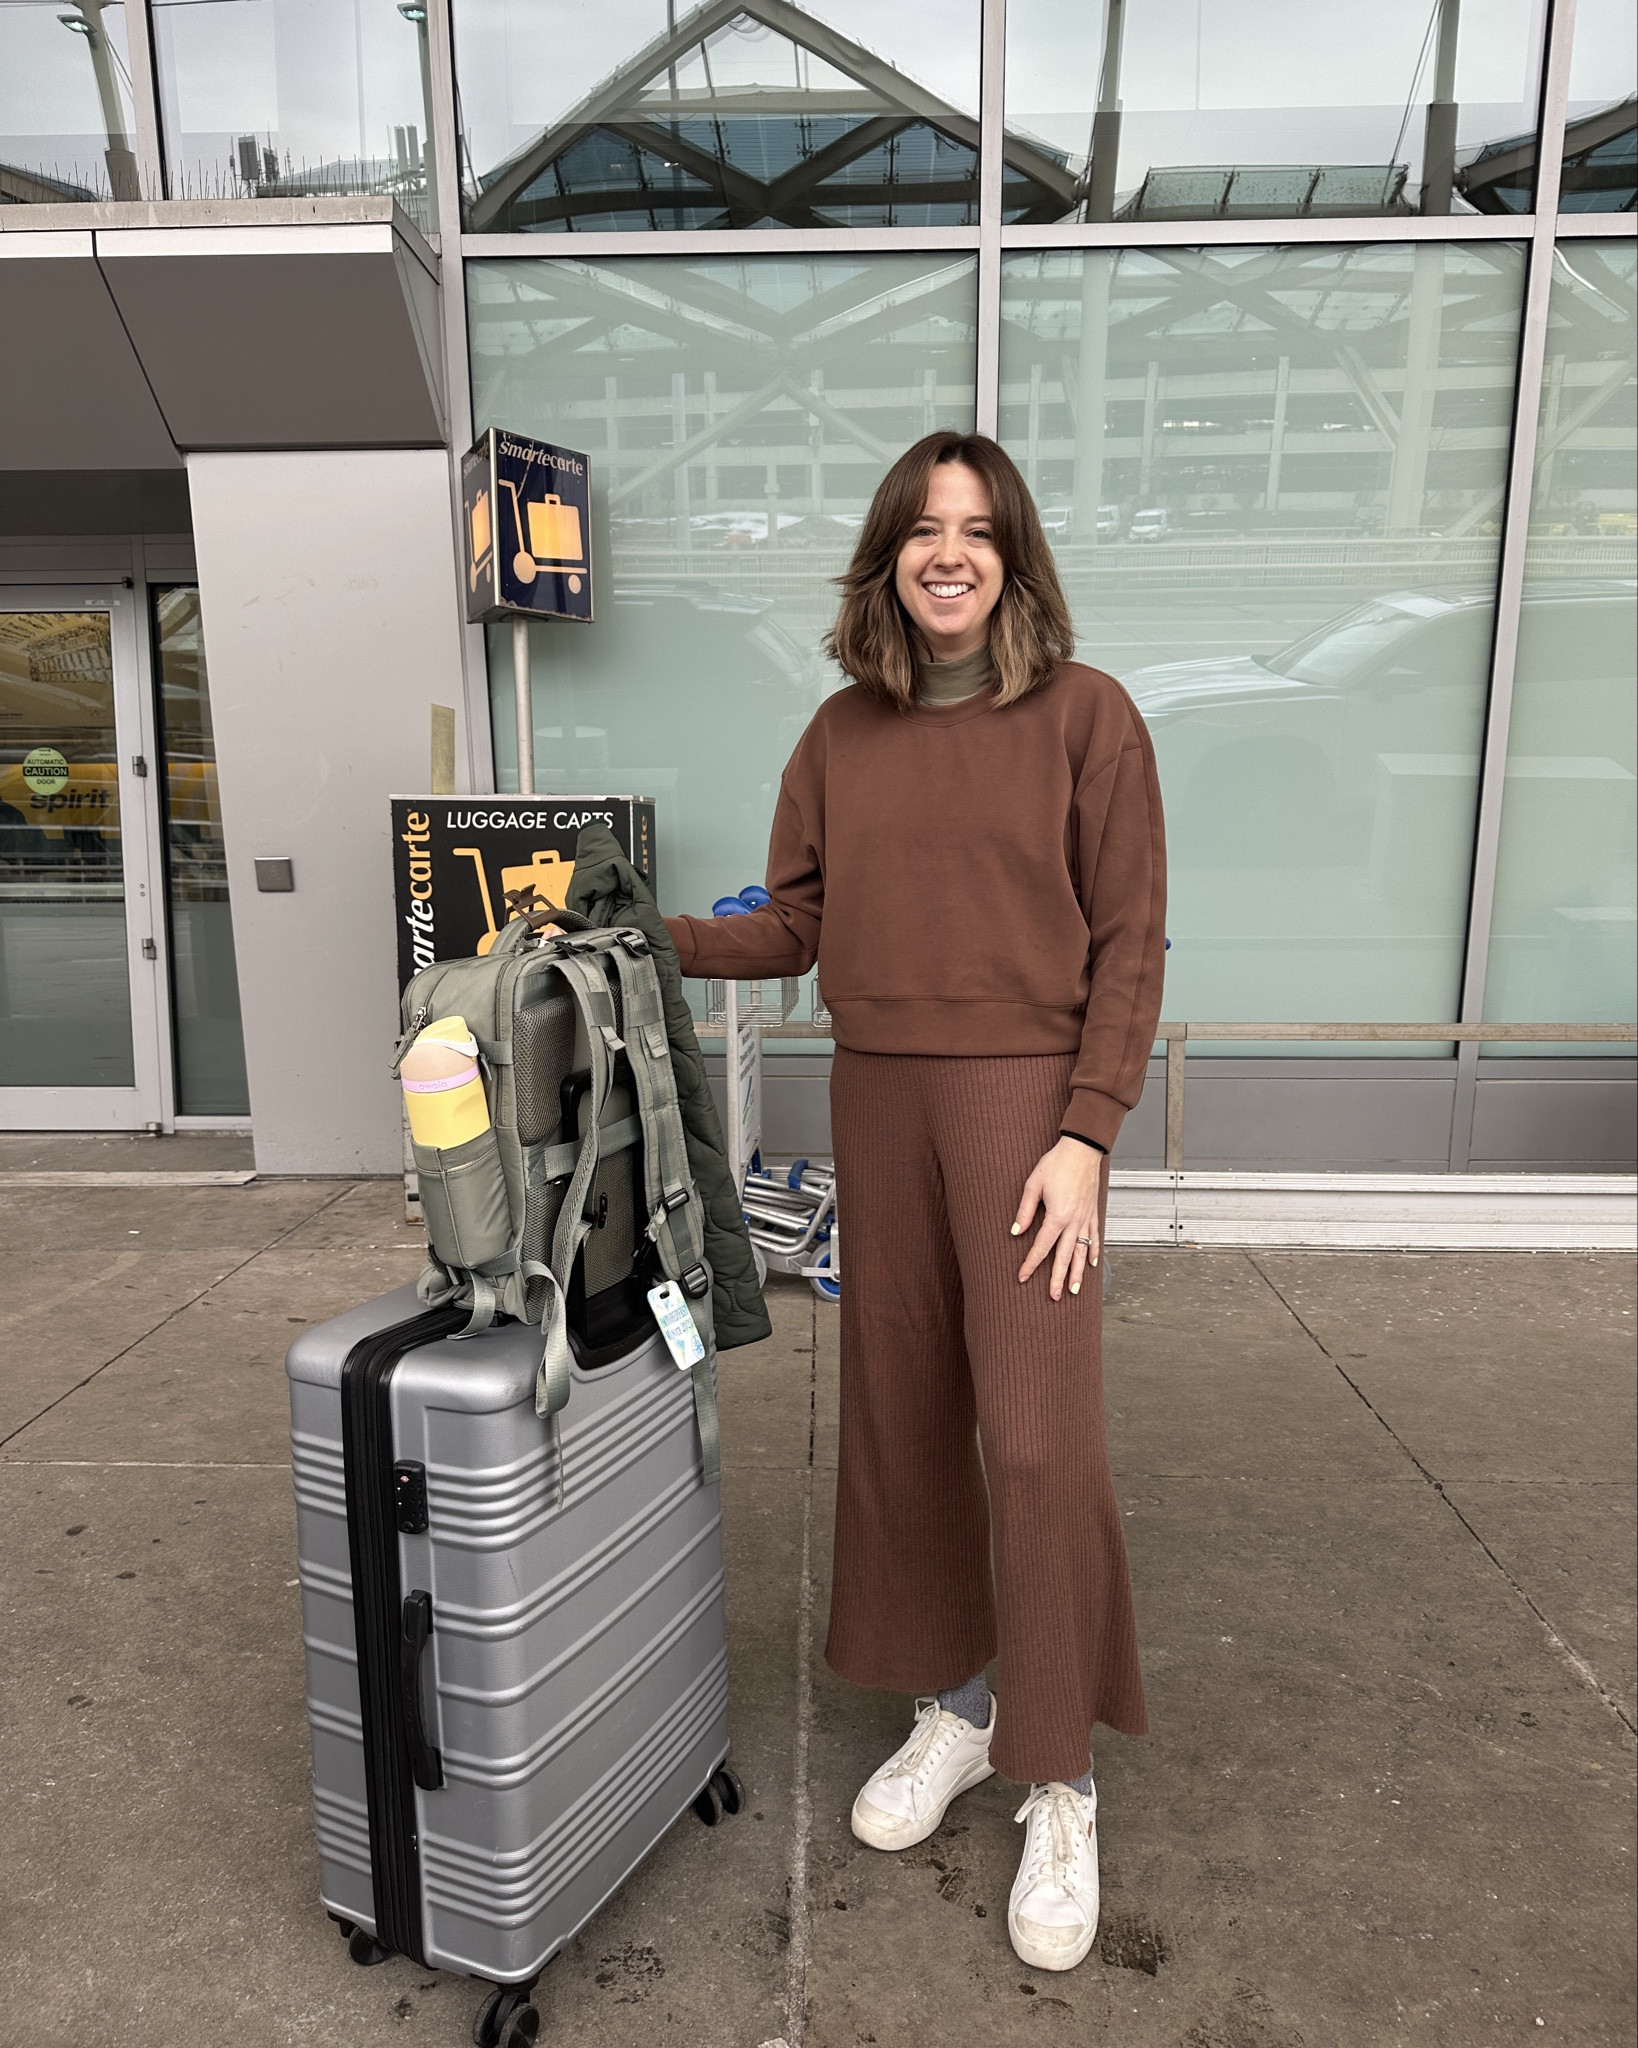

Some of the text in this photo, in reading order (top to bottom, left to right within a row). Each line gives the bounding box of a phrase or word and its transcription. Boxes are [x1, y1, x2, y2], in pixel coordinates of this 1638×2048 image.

[498, 441, 584, 477] smartecarte
[24, 767, 68, 776] CAUTION
[30, 789, 110, 814] spirit
[447, 811, 547, 829] LUGGAGE
[401, 811, 435, 976] artecarte
